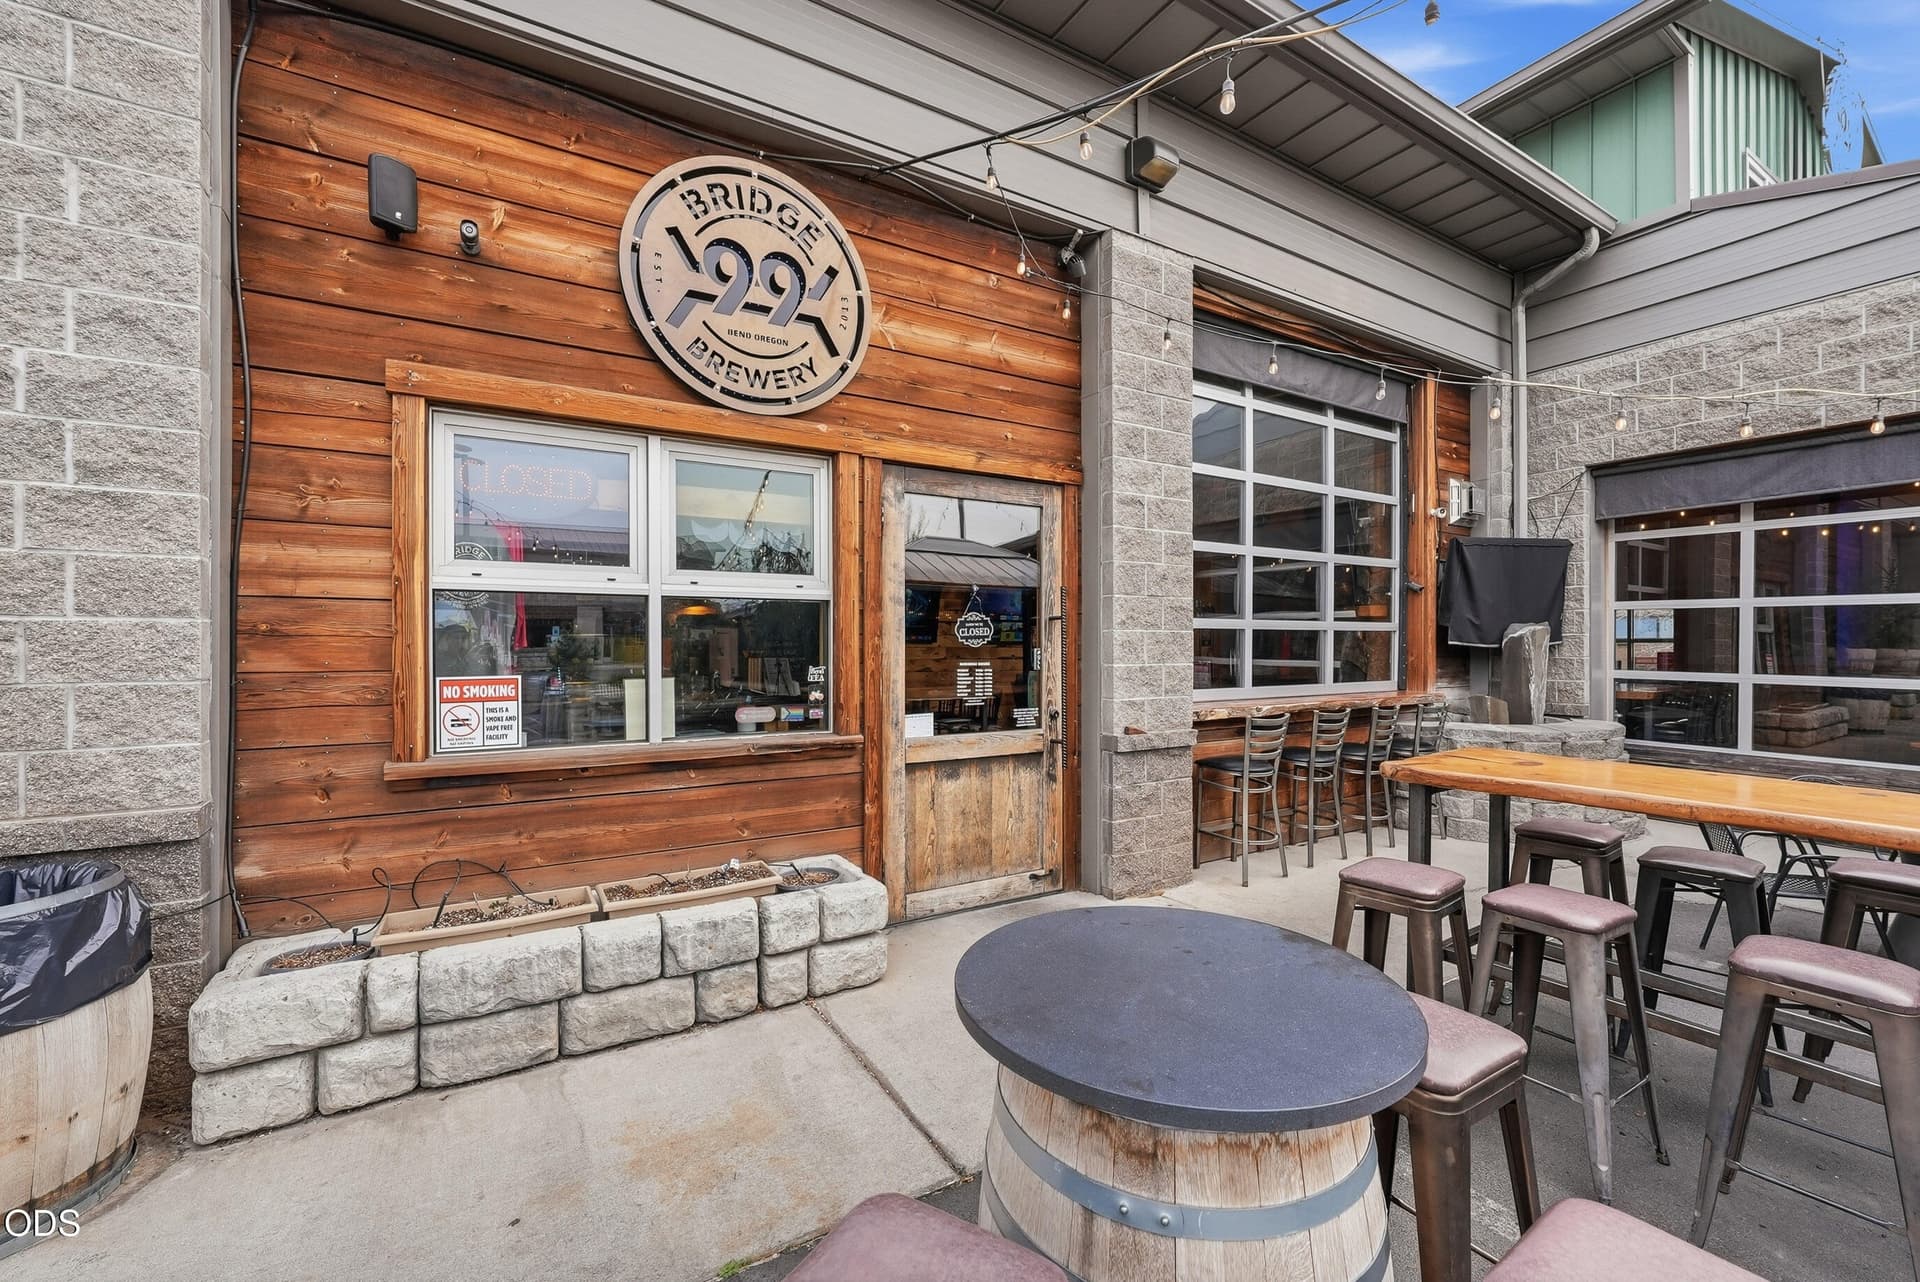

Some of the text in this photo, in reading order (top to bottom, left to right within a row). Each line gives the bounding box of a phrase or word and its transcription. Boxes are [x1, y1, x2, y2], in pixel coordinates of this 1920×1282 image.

[680, 182, 825, 252] BRIDGE
[702, 238, 806, 329] 99
[839, 296, 849, 331] 2013
[727, 328, 789, 347] BEND OREGON
[686, 336, 819, 390] BREWERY
[459, 459, 593, 501] CLOSED
[456, 546, 486, 560] RIDGE
[959, 628, 990, 637] CLOSED
[443, 684, 516, 698] NO SMOKING
